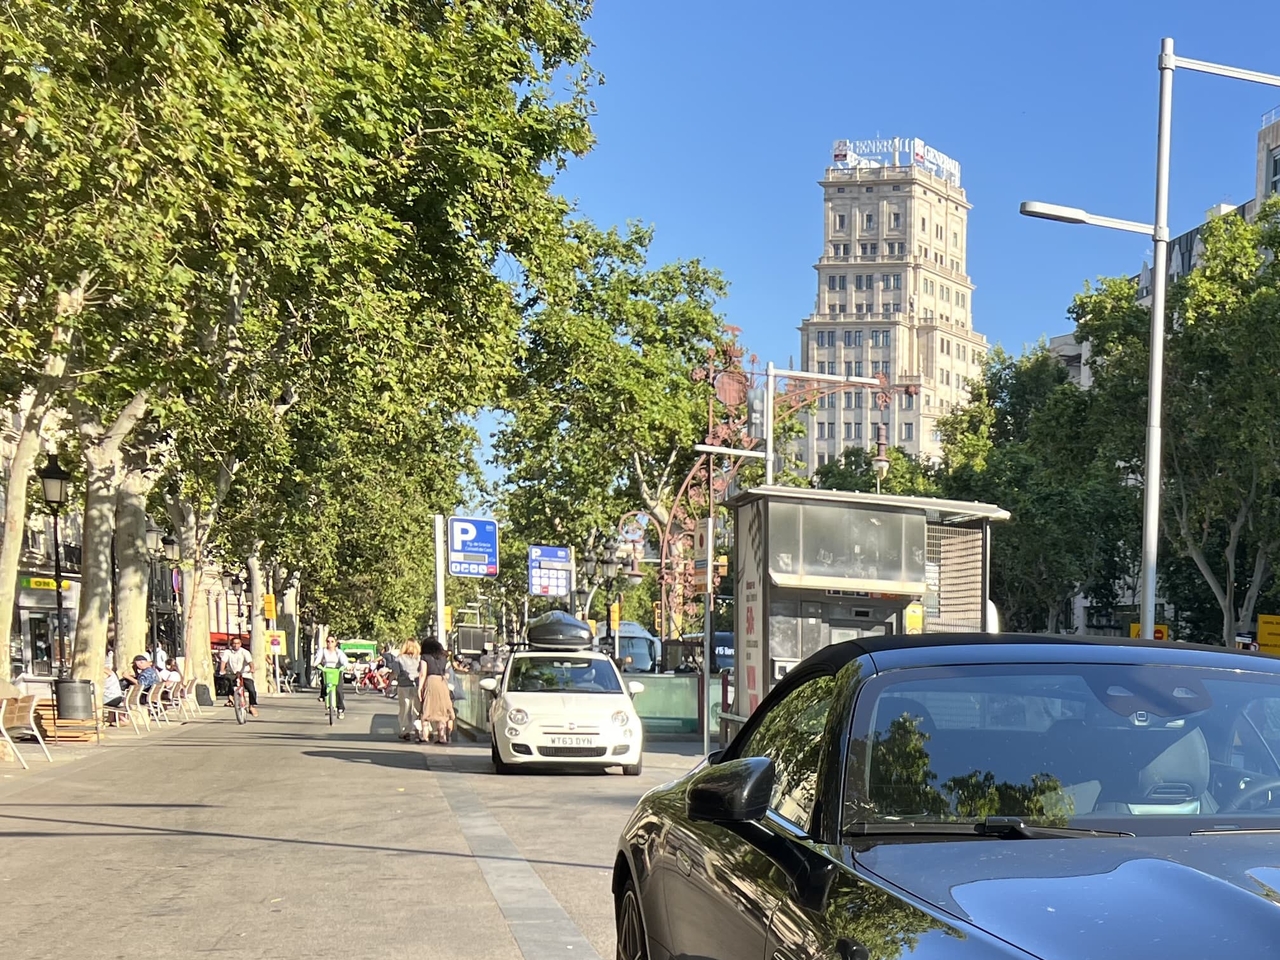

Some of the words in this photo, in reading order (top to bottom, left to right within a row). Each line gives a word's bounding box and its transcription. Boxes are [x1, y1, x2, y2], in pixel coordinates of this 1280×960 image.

[453, 521, 477, 550] P
[532, 548, 541, 559] P
[550, 737, 574, 746] WT63
[575, 737, 593, 746] DYN
